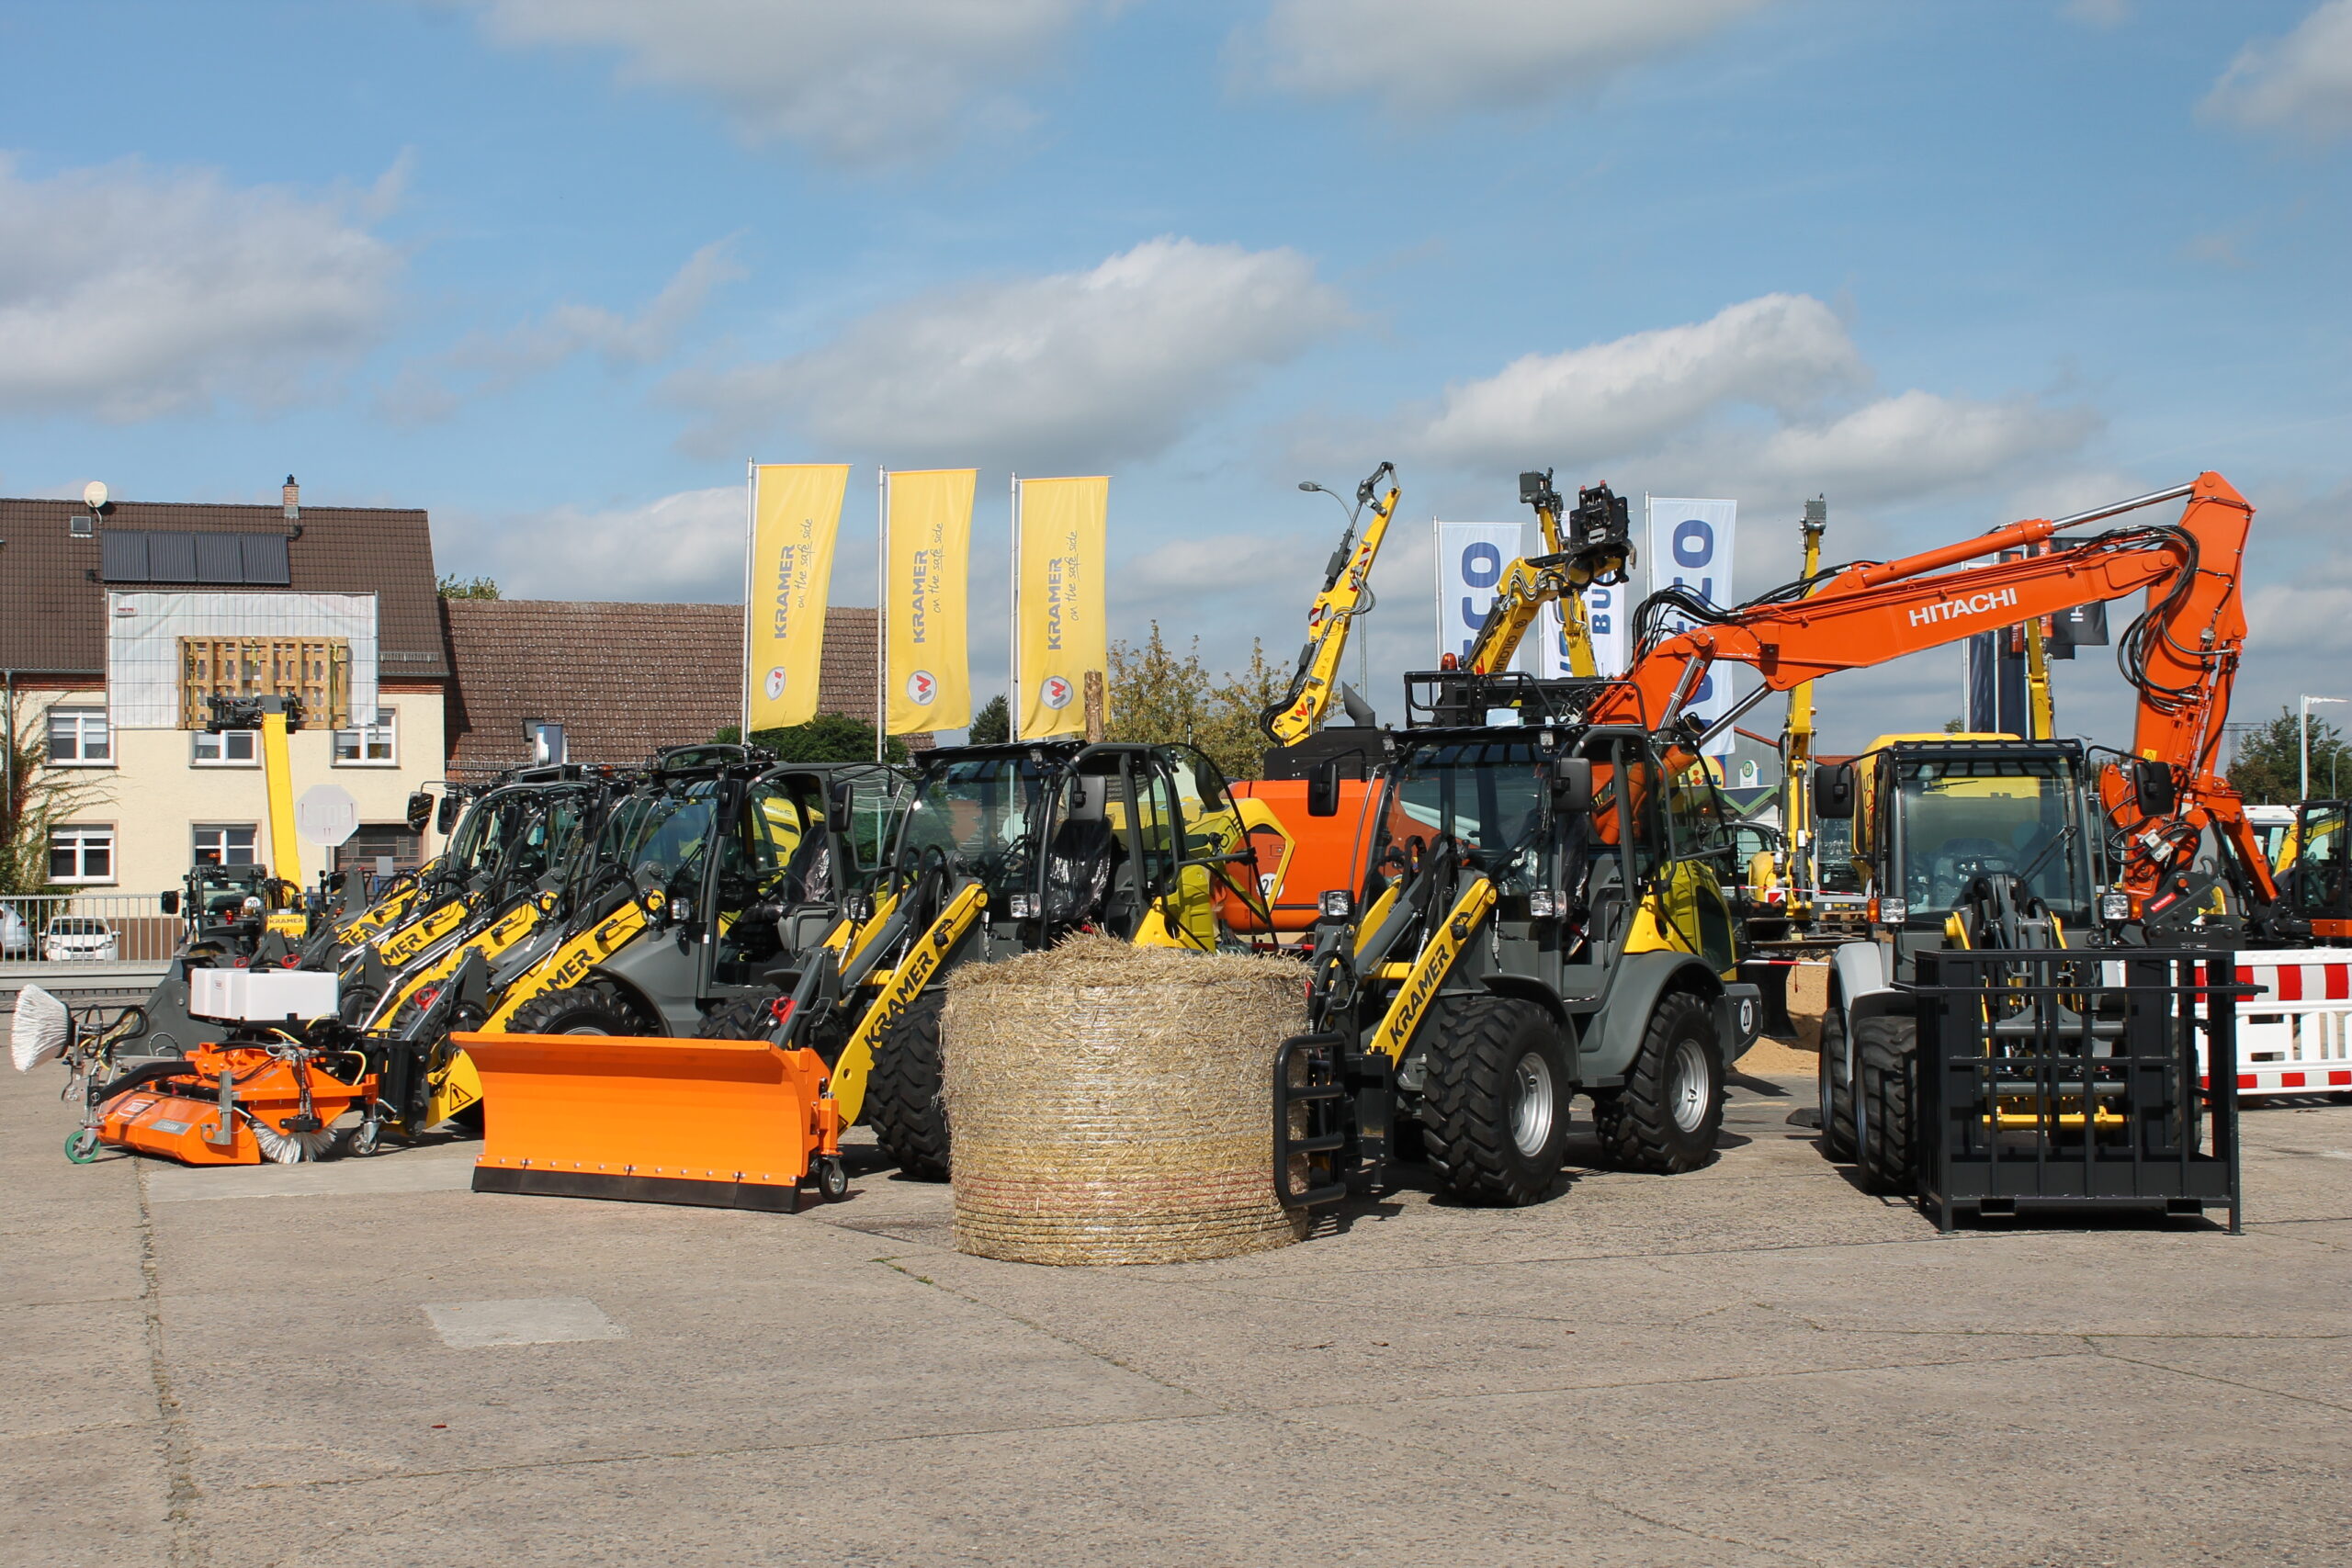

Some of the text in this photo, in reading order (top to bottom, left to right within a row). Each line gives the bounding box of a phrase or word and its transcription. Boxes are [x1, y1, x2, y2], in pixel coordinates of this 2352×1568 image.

[775, 545, 795, 638] KRAMER
[795, 518, 813, 608] on the safe side
[912, 549, 929, 643] KRAMER
[928, 523, 944, 613] on the safe side
[1047, 557, 1062, 649] KRAMER
[1065, 530, 1080, 621] on the safe side
[1908, 587, 2018, 626] HITACHI
[1389, 943, 1450, 1047] KRAMER
[1743, 1005, 1750, 1027] 20
